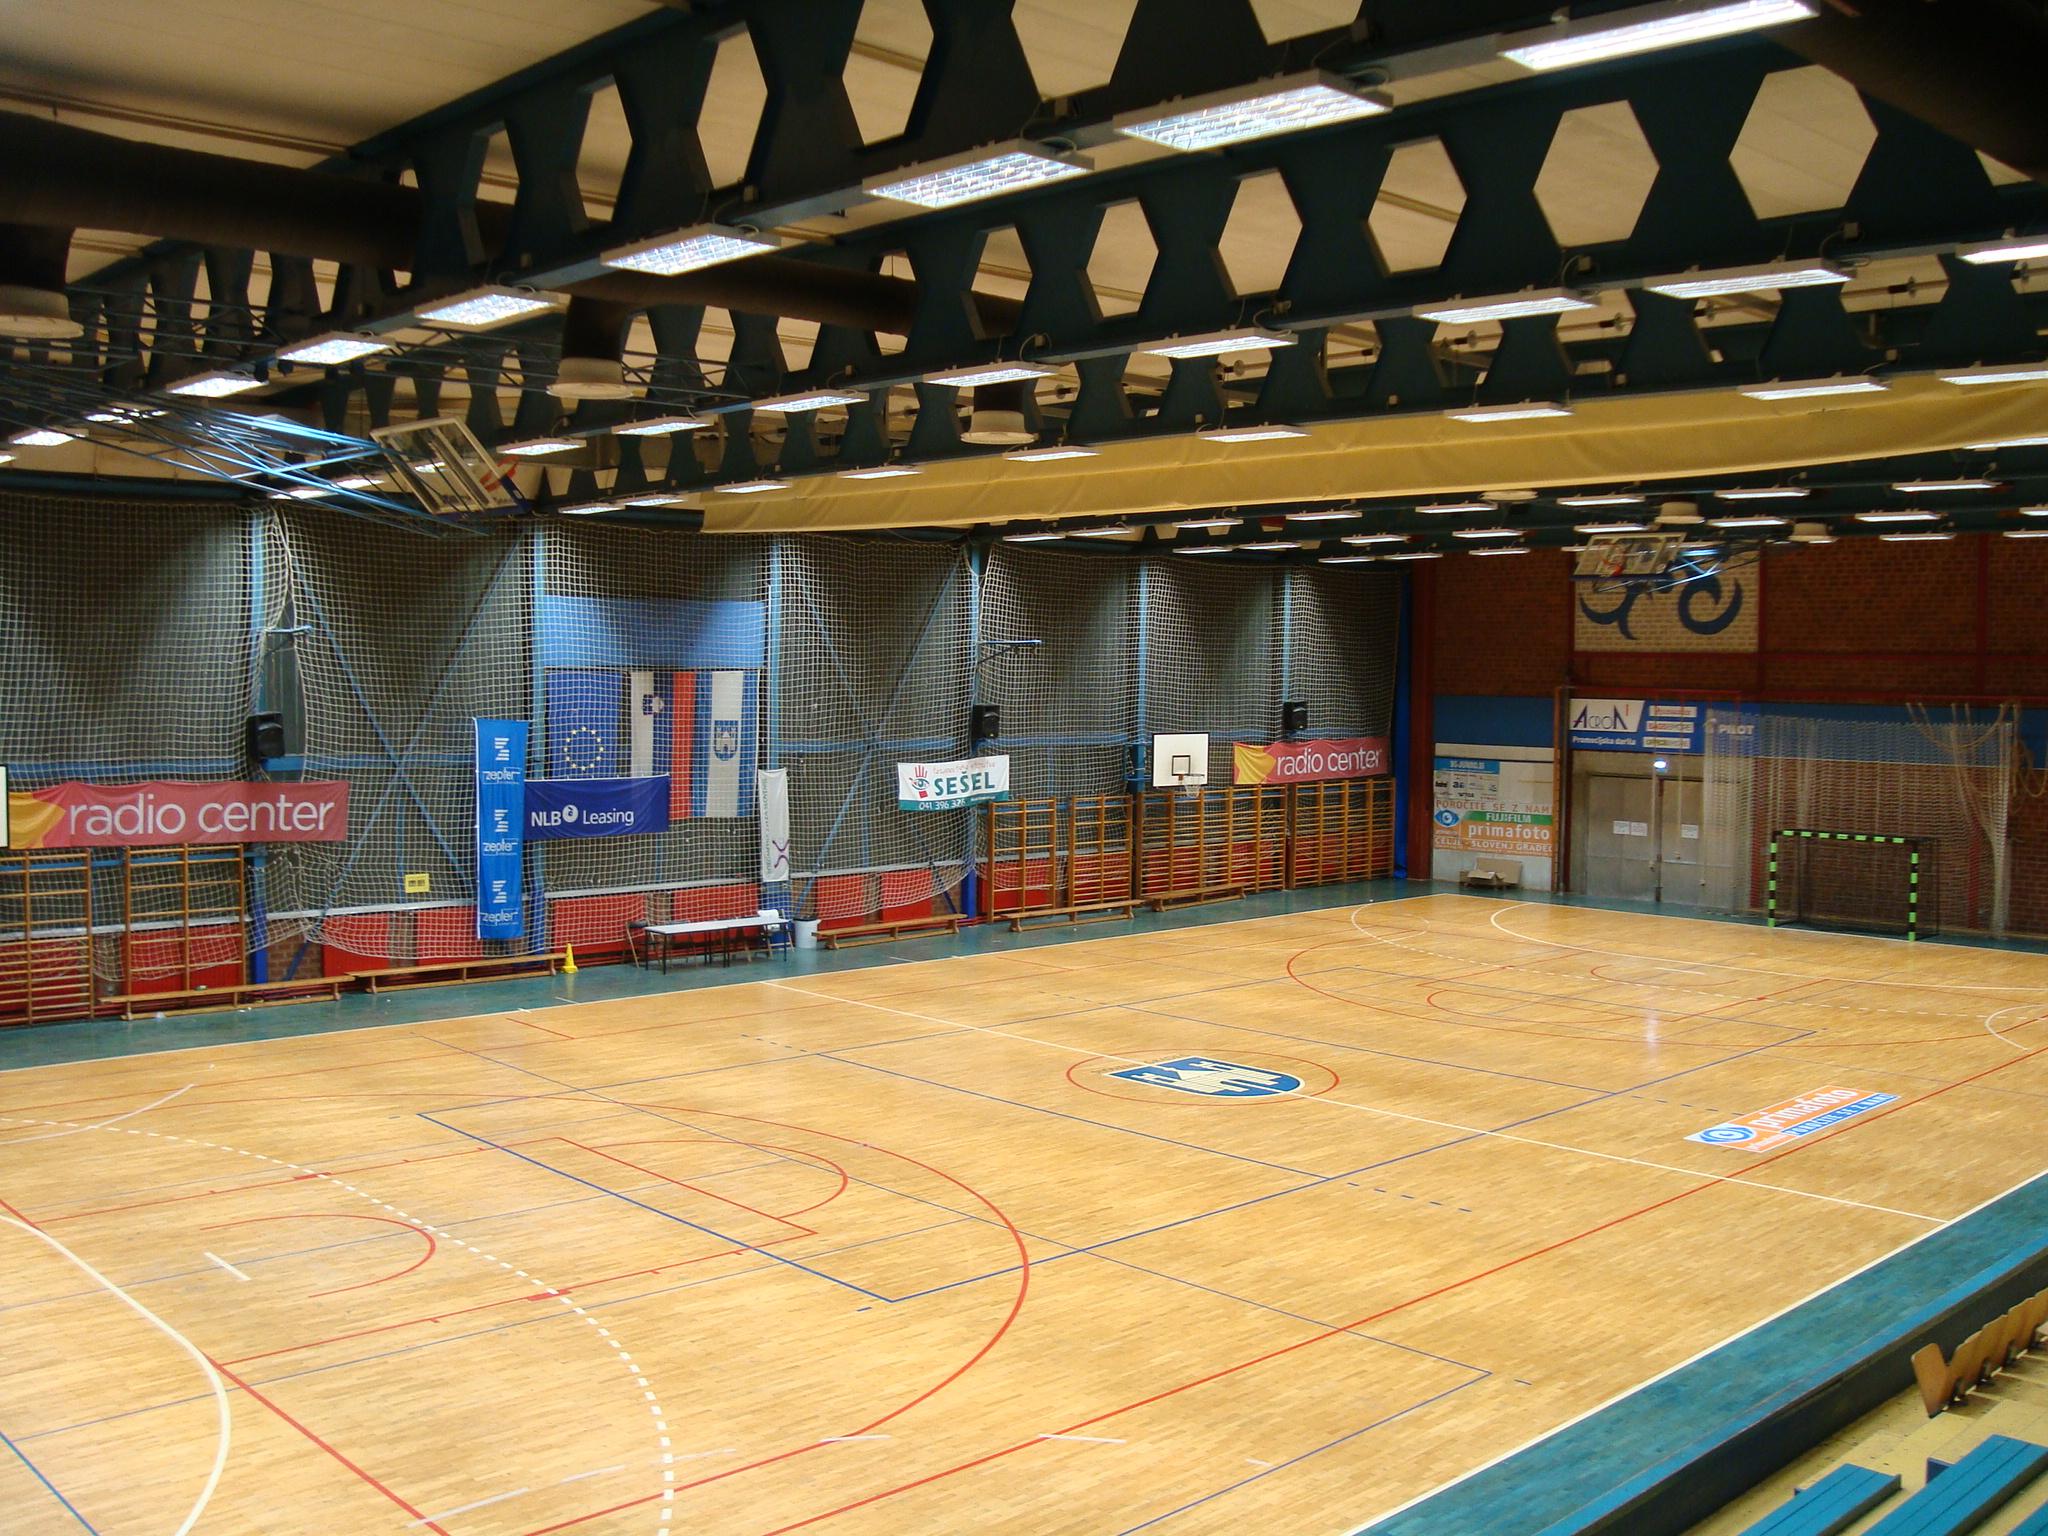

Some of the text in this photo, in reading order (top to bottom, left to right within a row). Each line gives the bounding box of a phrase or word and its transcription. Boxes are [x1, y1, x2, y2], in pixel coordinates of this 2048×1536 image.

[1277, 748, 1381, 776] radio center
[934, 771, 995, 796] SEŠEL
[70, 793, 335, 836] radio center
[919, 802, 932, 810] 041
[1493, 803, 1504, 811] SE
[1512, 804, 1518, 812] Z
[531, 808, 634, 827] NLB Leasing
[1486, 813, 1531, 823] FUJIFILM
[1468, 822, 1550, 839] primafoto
[1748, 1089, 1859, 1130] primafoto
